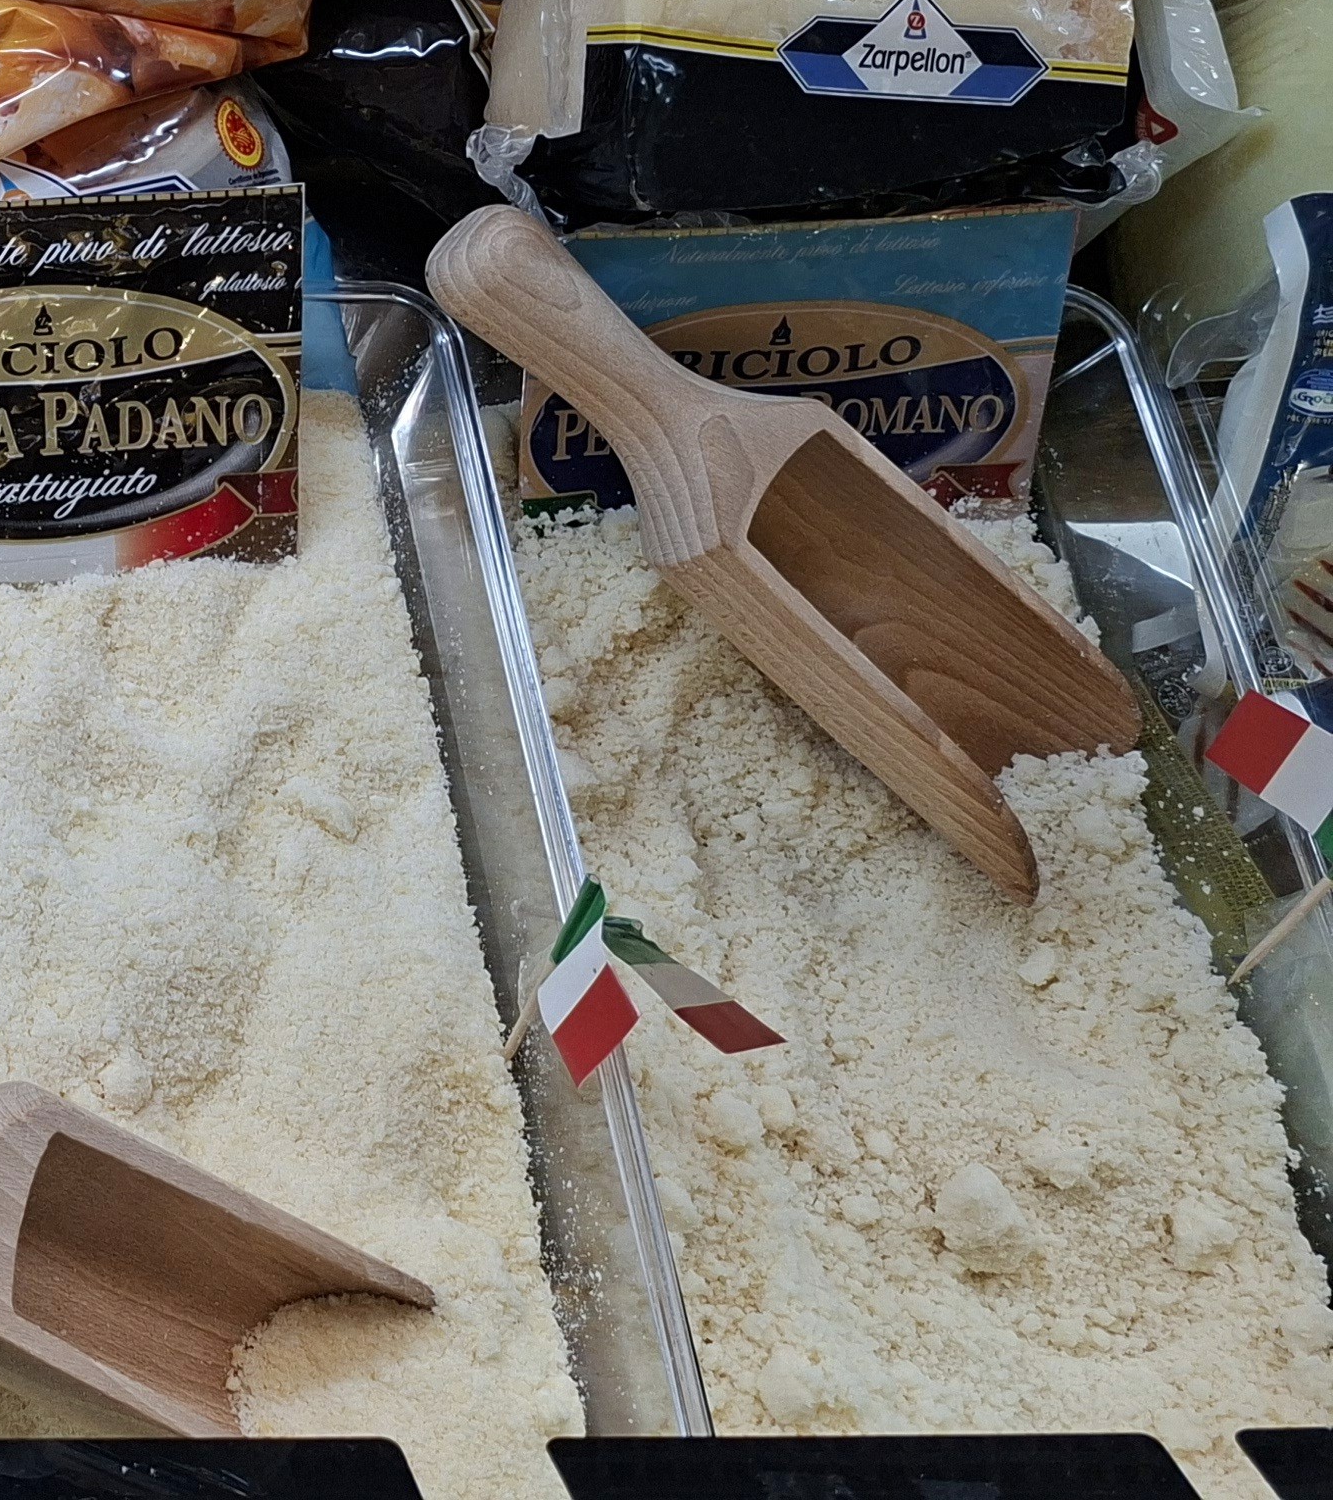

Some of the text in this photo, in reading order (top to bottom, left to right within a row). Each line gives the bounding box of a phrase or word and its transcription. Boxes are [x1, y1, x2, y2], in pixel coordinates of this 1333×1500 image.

[858, 43, 967, 77] Zarpellon
[29, 232, 118, 276] privo
[131, 223, 173, 259] di
[38, 390, 275, 459] PADANO
